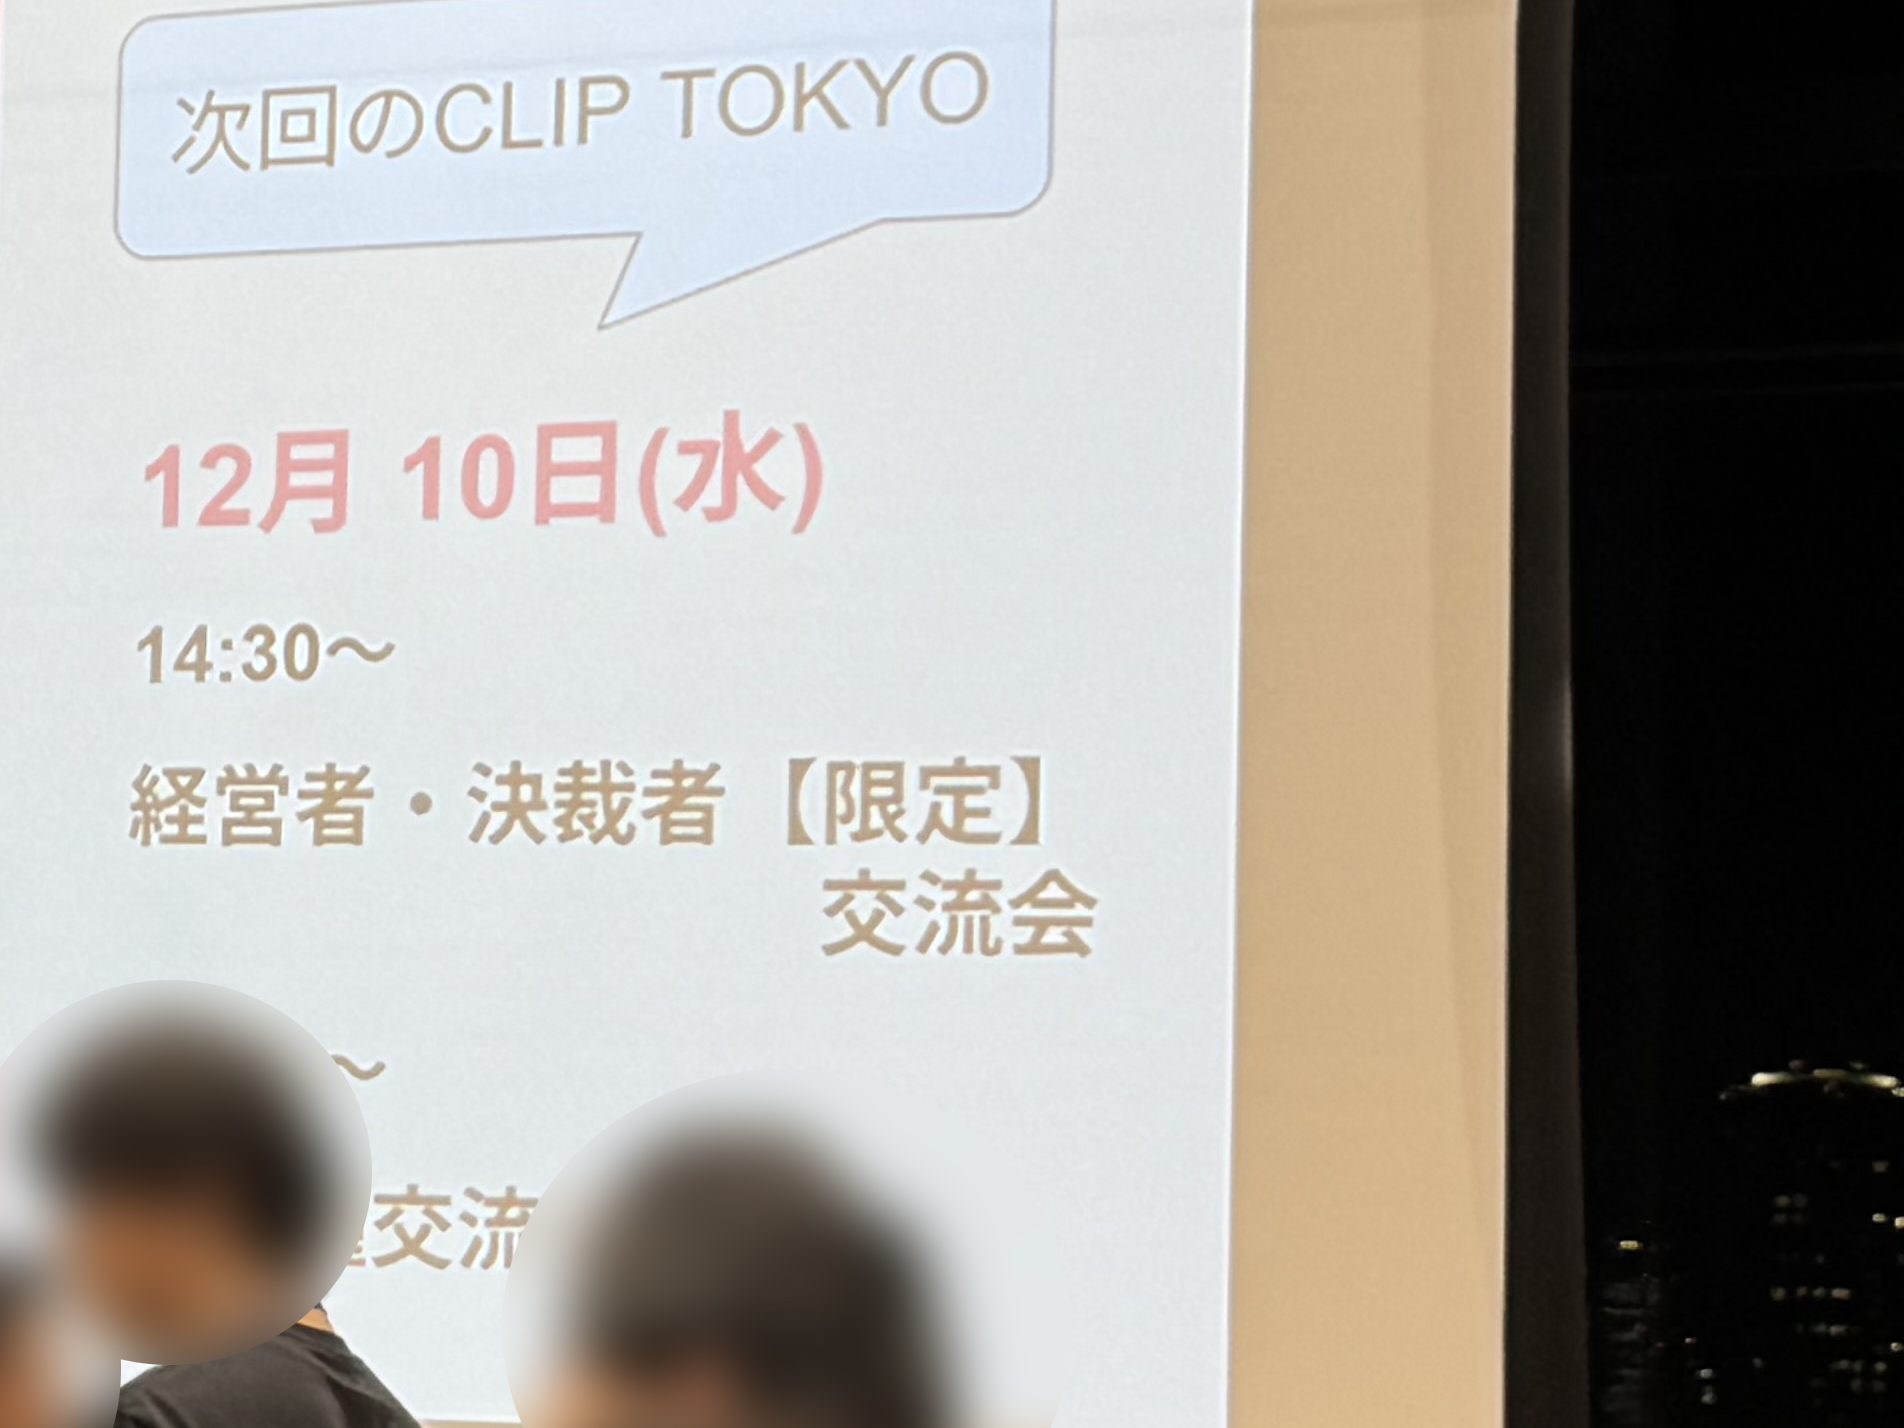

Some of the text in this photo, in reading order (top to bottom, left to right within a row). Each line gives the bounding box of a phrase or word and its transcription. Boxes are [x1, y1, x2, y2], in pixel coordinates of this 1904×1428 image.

[170, 50, 990, 176] 次回のCLIP TOKYO
[143, 409, 826, 536] 12月 10日(水)
[820, 868, 1098, 959] 交流会
